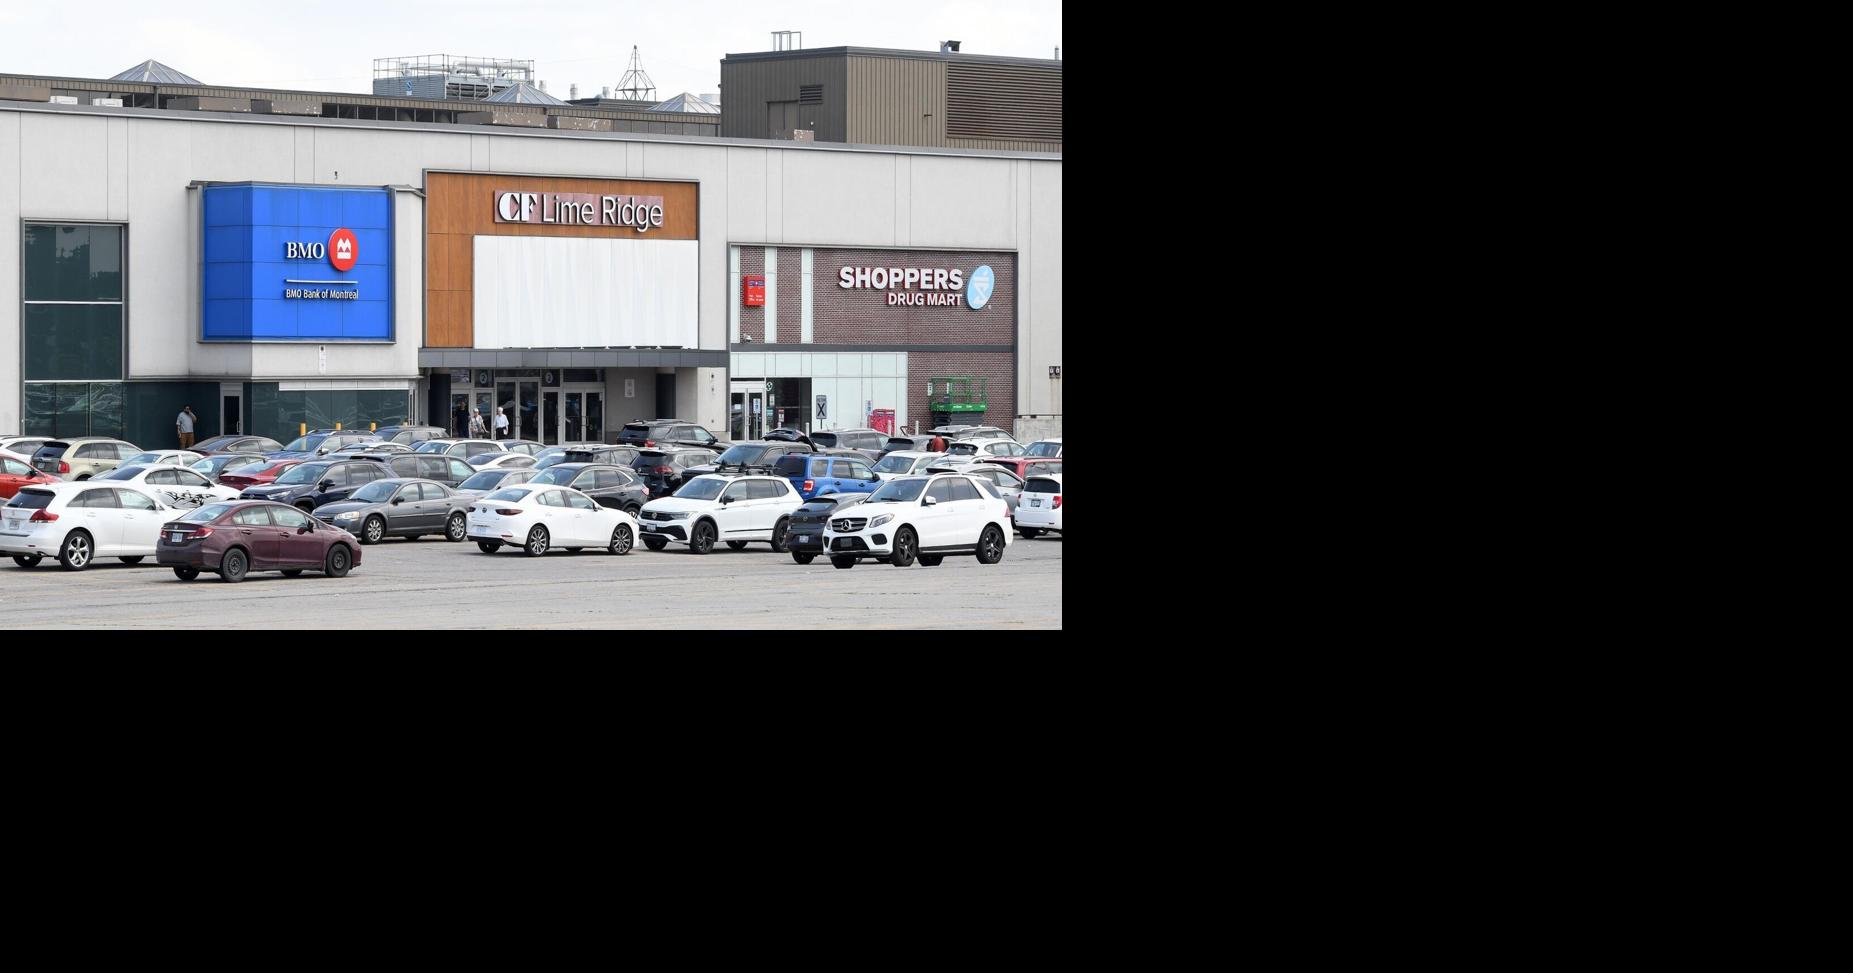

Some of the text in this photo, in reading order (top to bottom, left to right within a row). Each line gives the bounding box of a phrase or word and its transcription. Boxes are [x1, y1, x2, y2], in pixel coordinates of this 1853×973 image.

[498, 192, 663, 232] CF Lime Ridge
[286, 242, 325, 259] BMO
[838, 266, 963, 290] SHOPPERS
[286, 288, 359, 299] BMO Bank of Montreal
[888, 293, 963, 306] DRUG MART
